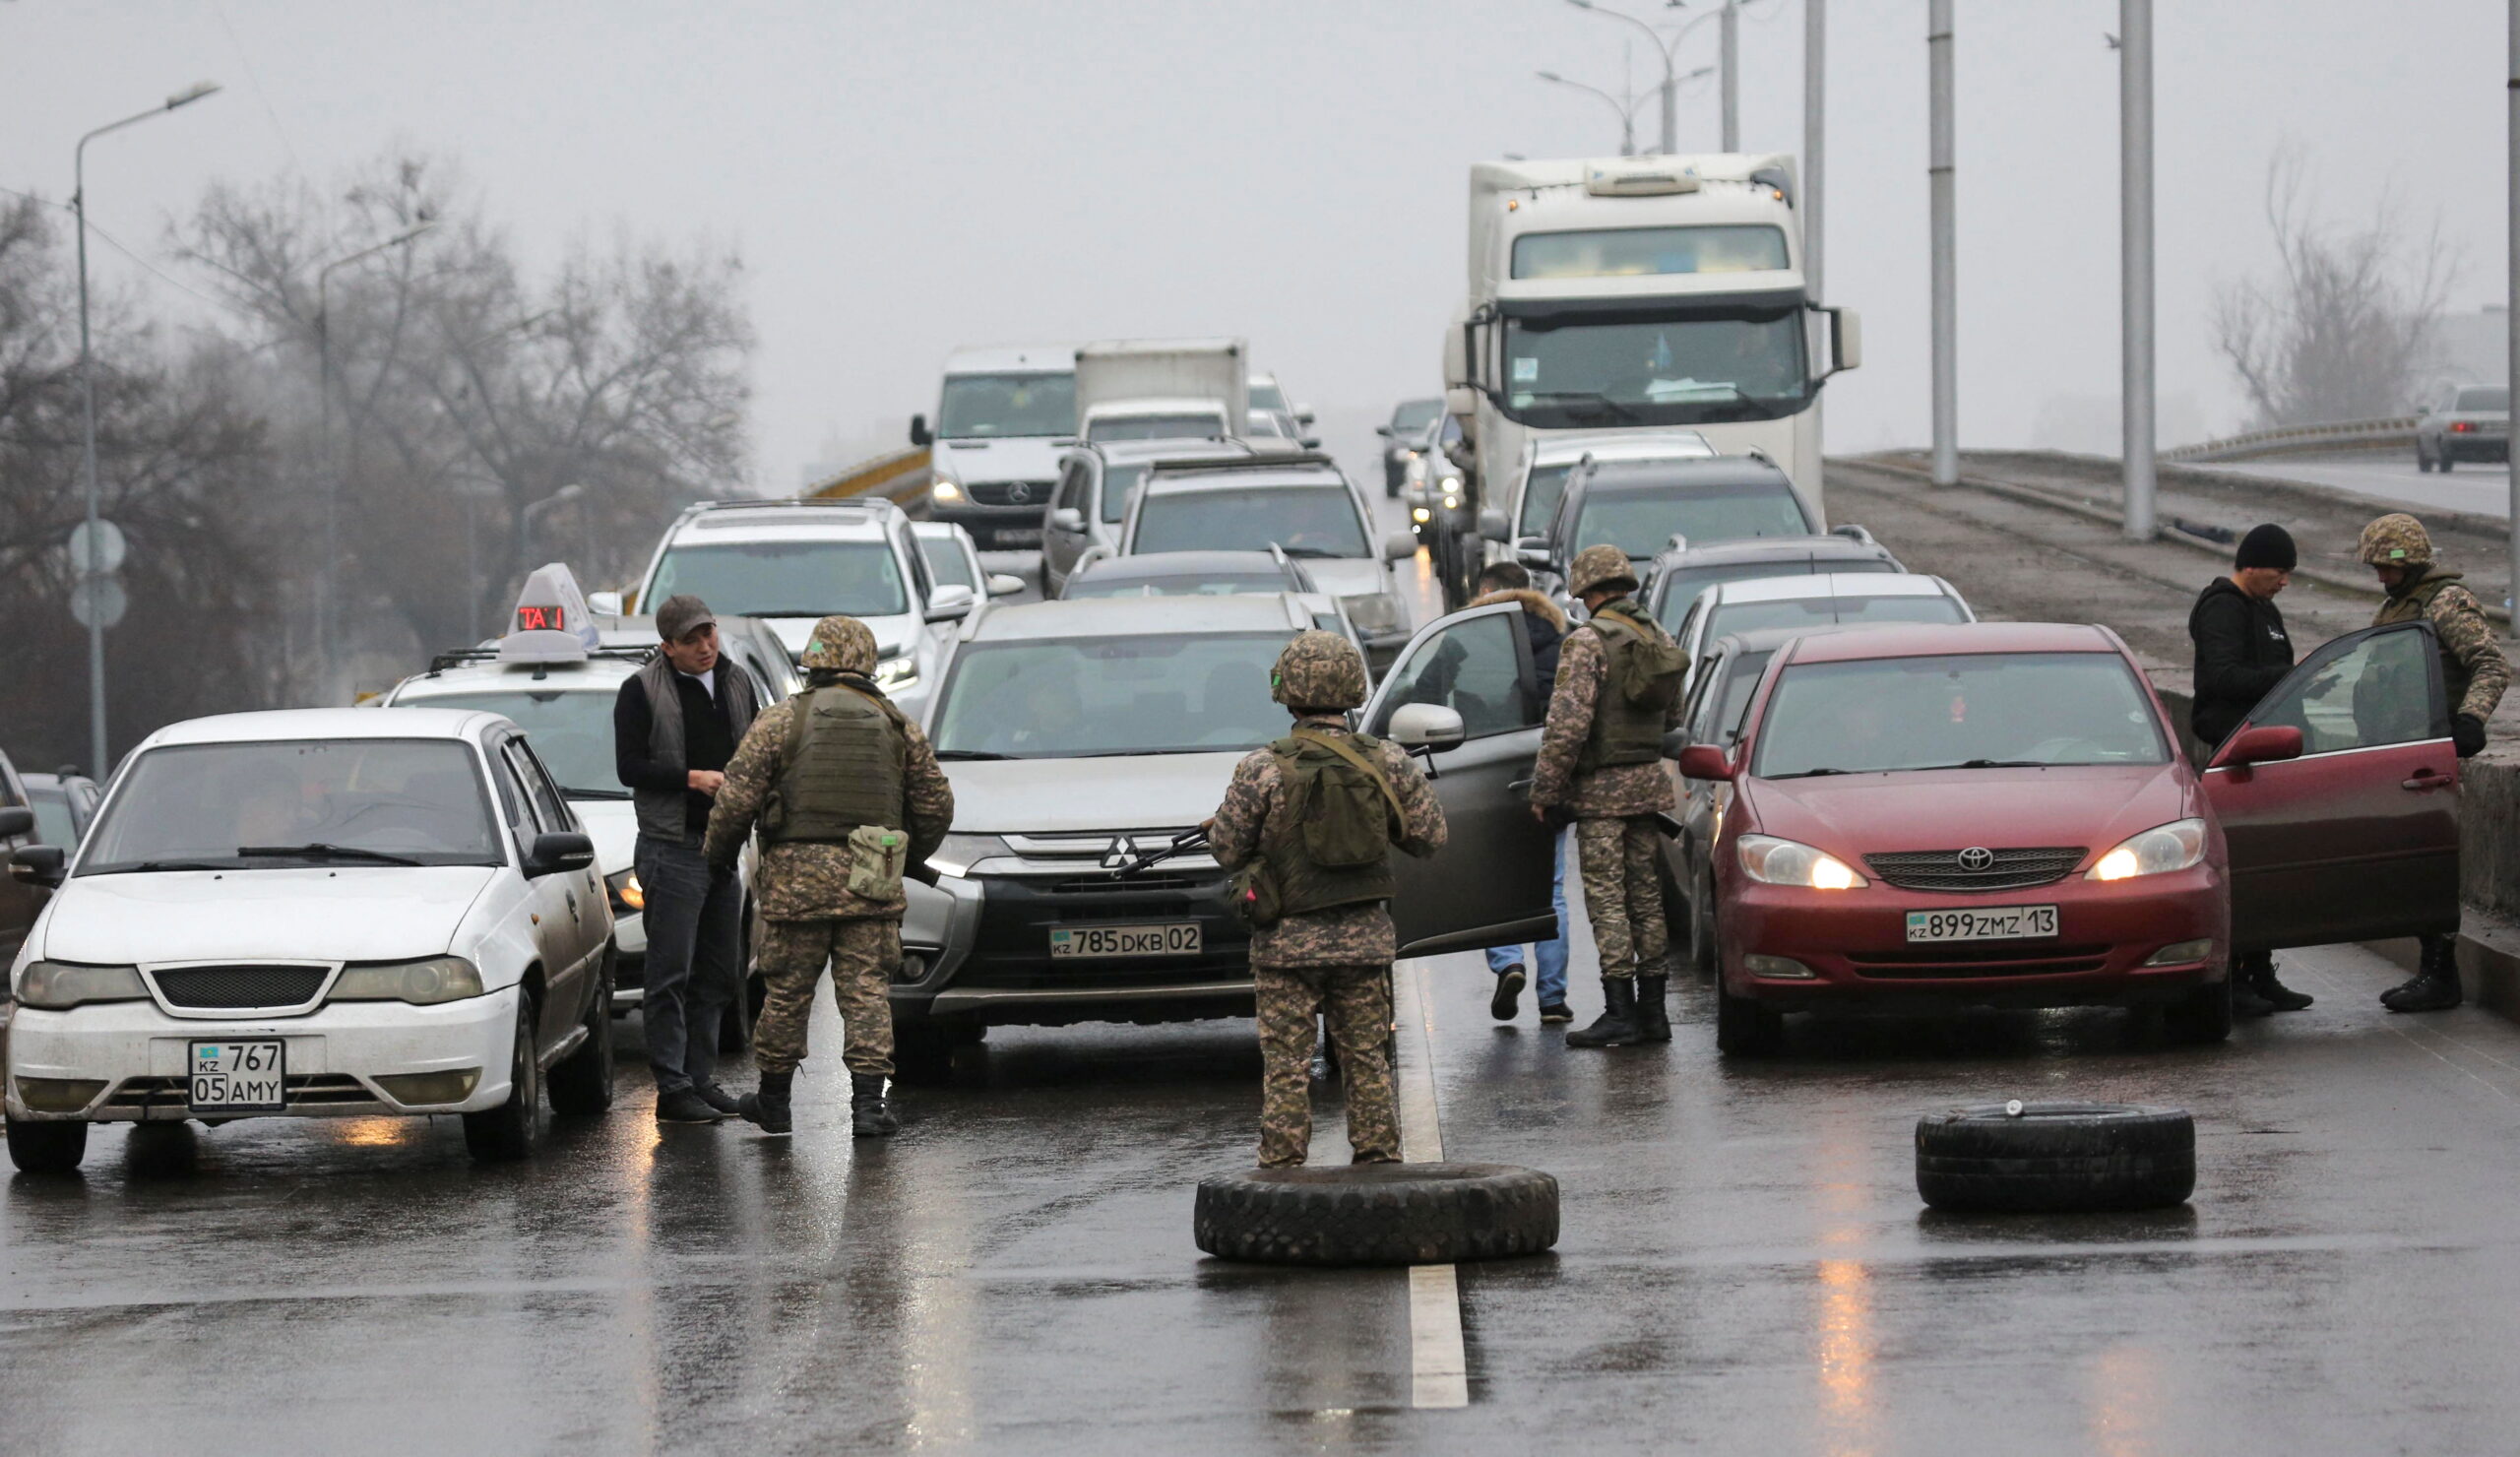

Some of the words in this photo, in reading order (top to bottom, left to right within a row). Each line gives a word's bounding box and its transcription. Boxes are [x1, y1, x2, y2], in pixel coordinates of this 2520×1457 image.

[519, 606, 563, 630] TAI
[1909, 928, 1926, 938] KZ
[2028, 909, 2053, 932] 13
[1053, 944, 1071, 954] KZ
[1168, 927, 1198, 950] 02
[200, 1061, 219, 1072] KZ
[228, 1045, 279, 1071] 767
[195, 1078, 225, 1102] 05
[230, 1081, 280, 1102] AMY
